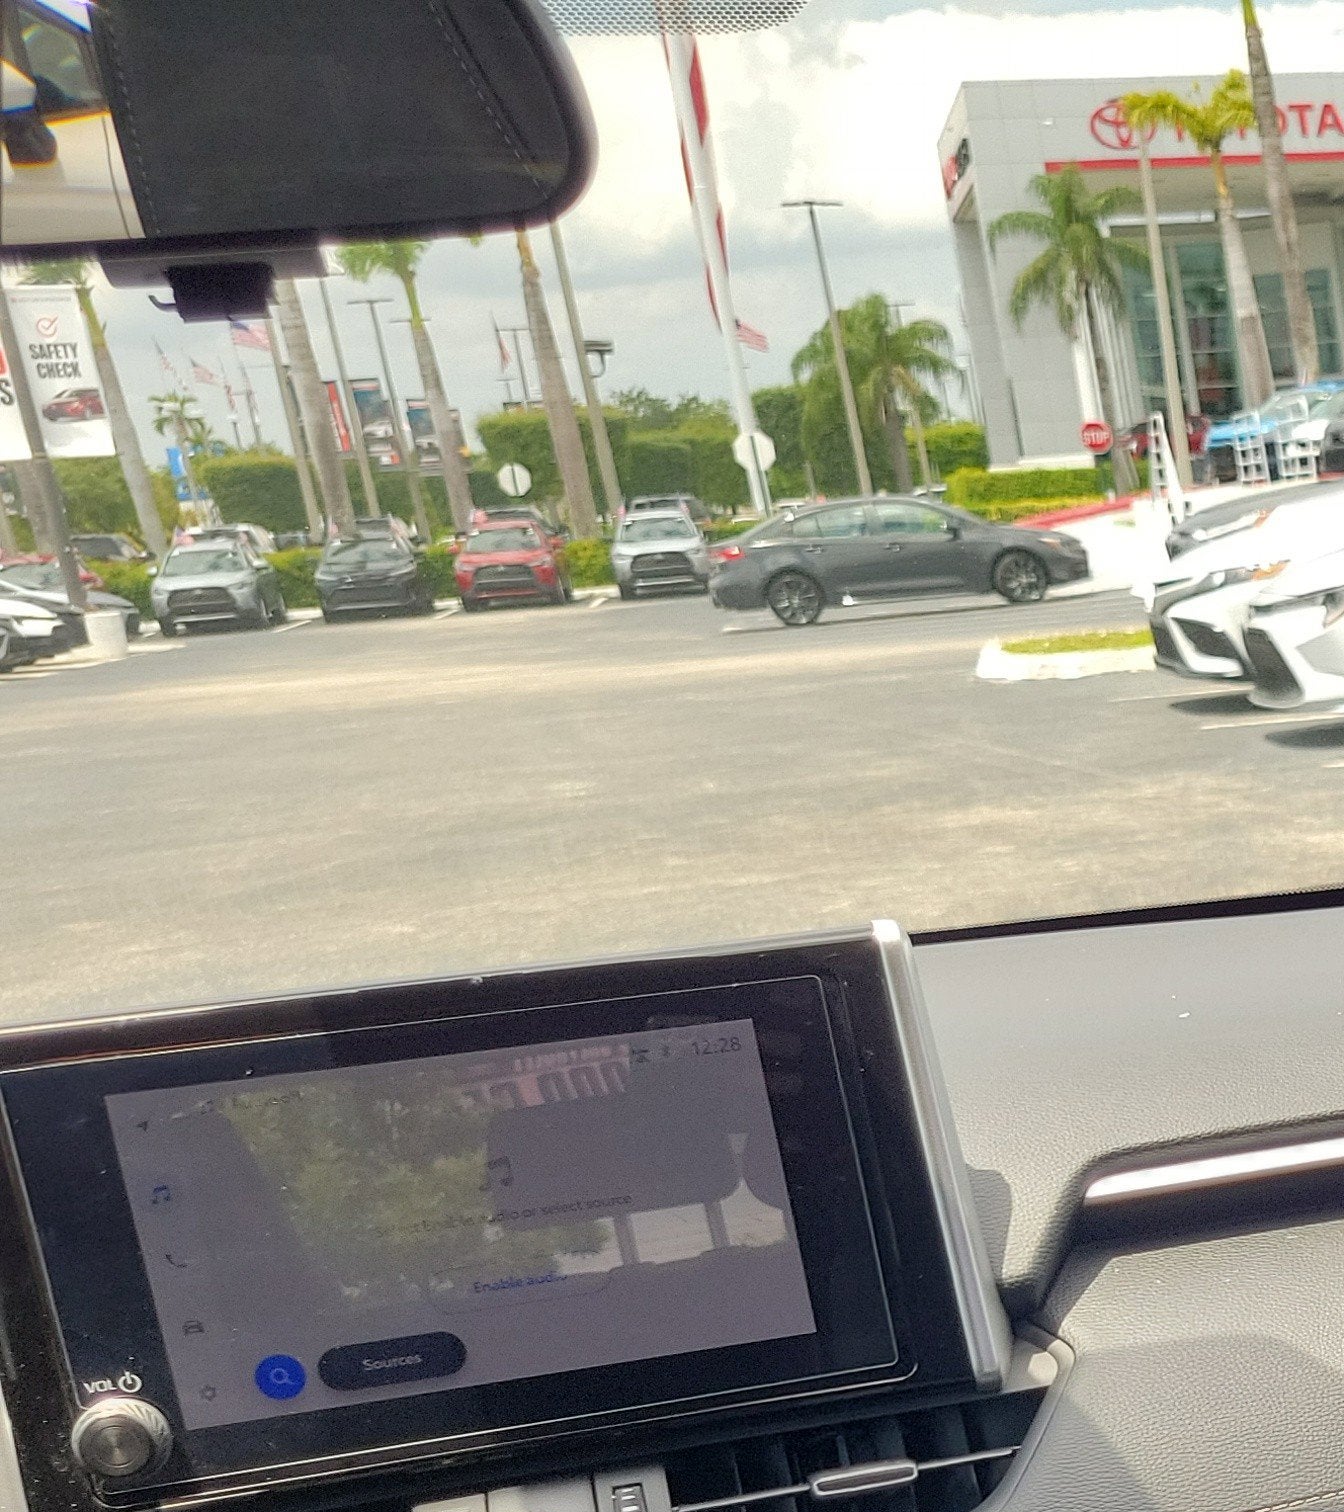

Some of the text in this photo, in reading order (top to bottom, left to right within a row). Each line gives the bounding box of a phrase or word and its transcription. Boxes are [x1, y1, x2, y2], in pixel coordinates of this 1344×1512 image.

[29, 343, 79, 360] SAFETY
[37, 362, 82, 379] CHECK
[1082, 430, 1110, 445] STOP
[362, 1354, 422, 1371] Sources
[83, 1379, 117, 1394] VOL
